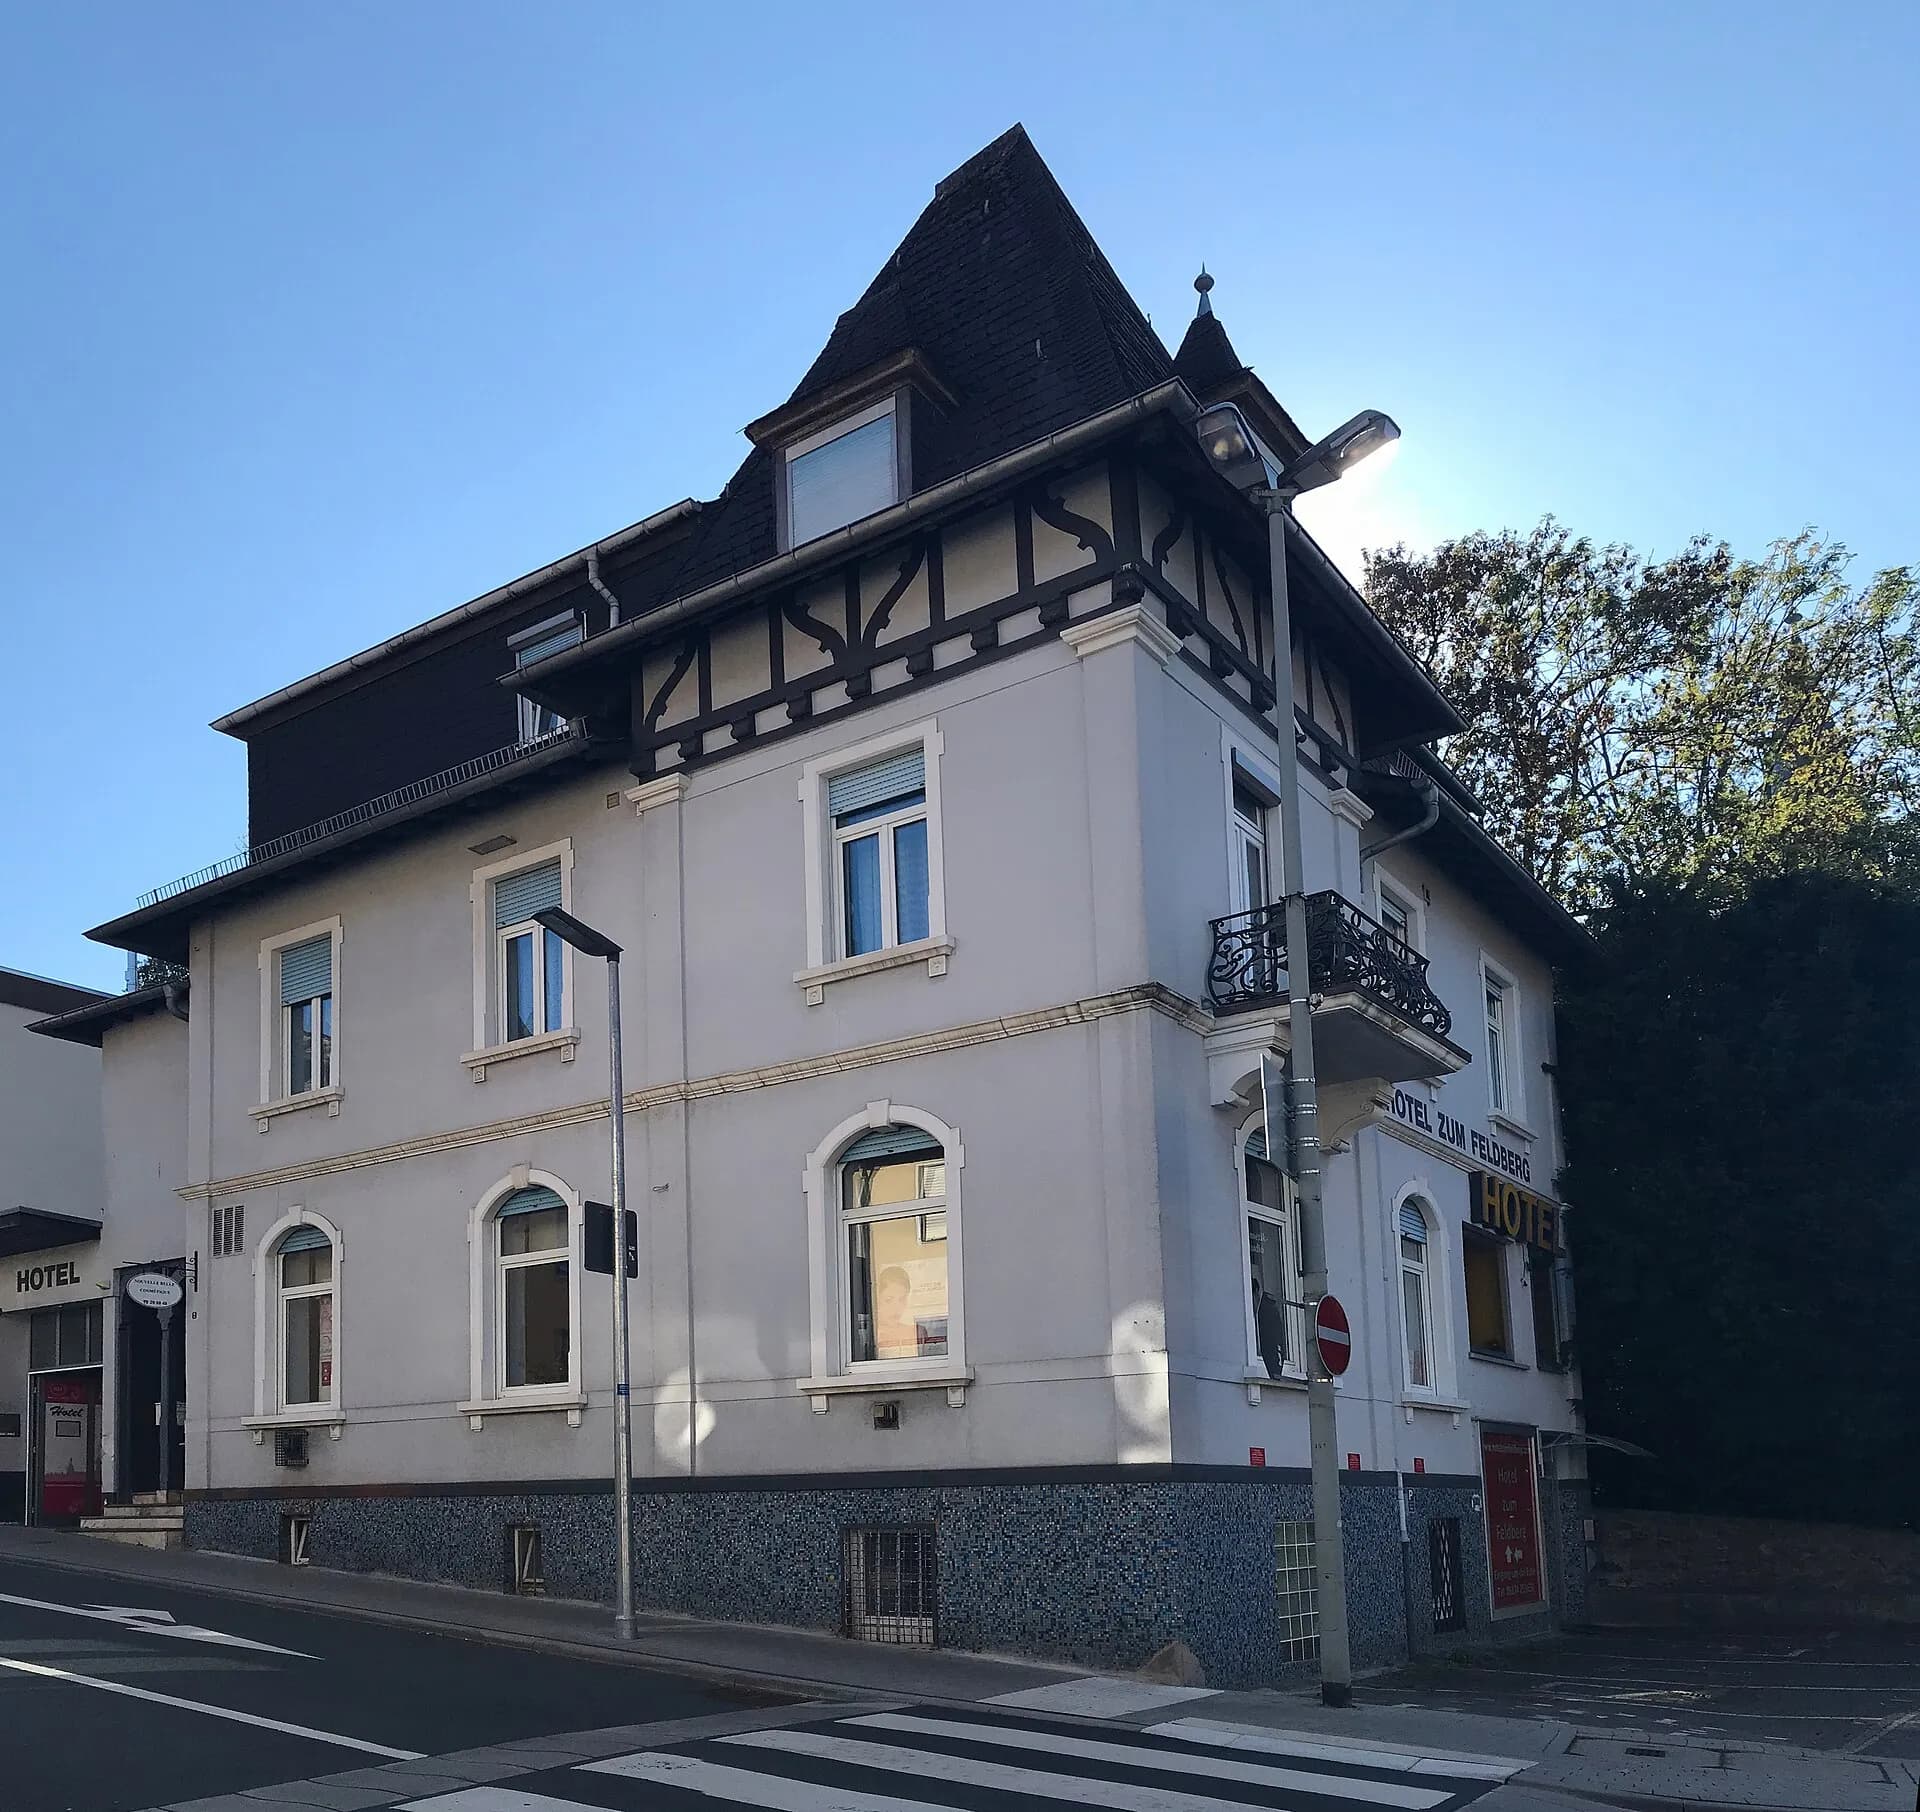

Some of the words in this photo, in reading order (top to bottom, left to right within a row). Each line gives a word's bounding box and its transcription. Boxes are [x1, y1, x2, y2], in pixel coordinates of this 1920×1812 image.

[1437, 1111, 1466, 1151] ZUM
[1470, 1129, 1531, 1184] FELDBERG
[17, 1261, 81, 1293] HOTEL
[49, 1405, 84, 1417] Hotel
